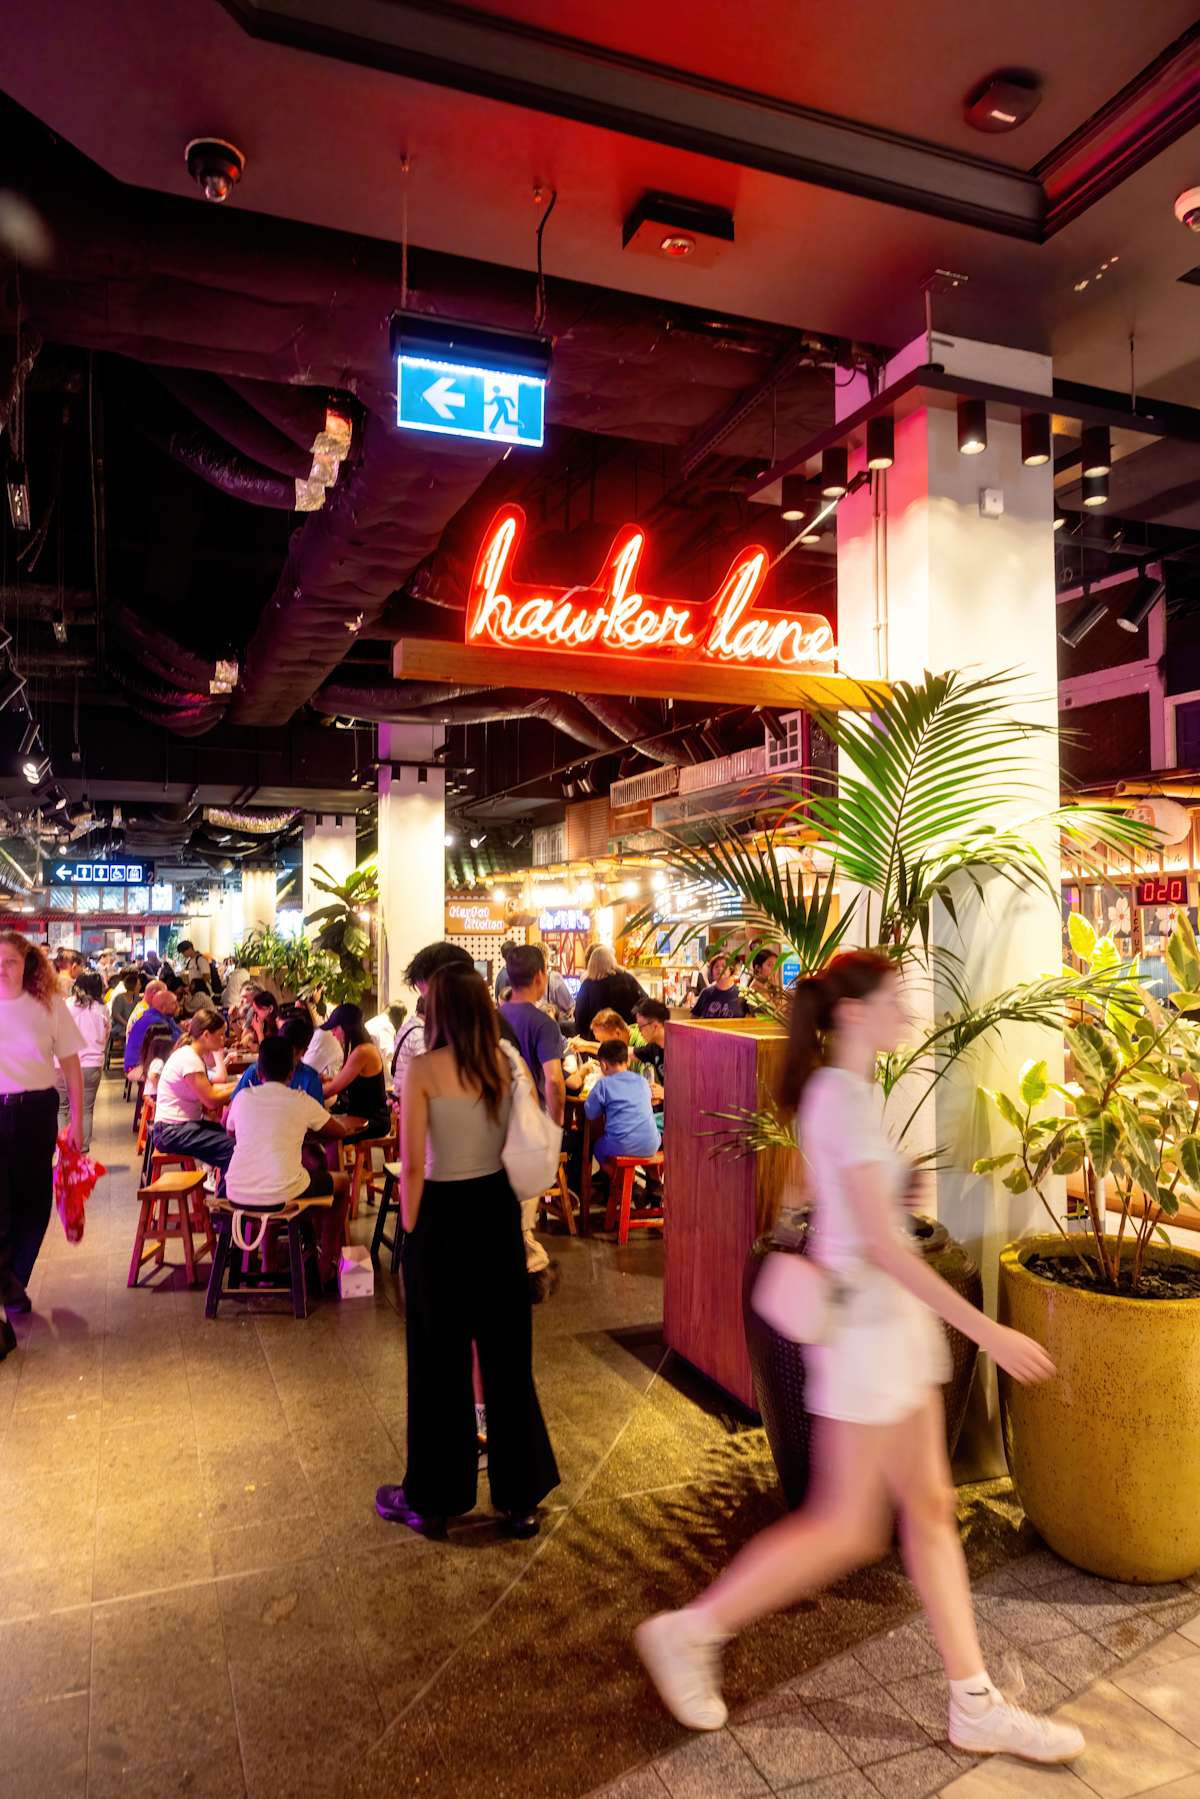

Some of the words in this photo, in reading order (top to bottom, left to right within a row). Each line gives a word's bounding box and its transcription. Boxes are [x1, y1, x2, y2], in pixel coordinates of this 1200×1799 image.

[471, 516, 694, 647] hawker
[708, 552, 841, 662] lane
[1144, 881, 1182, 902] 020
